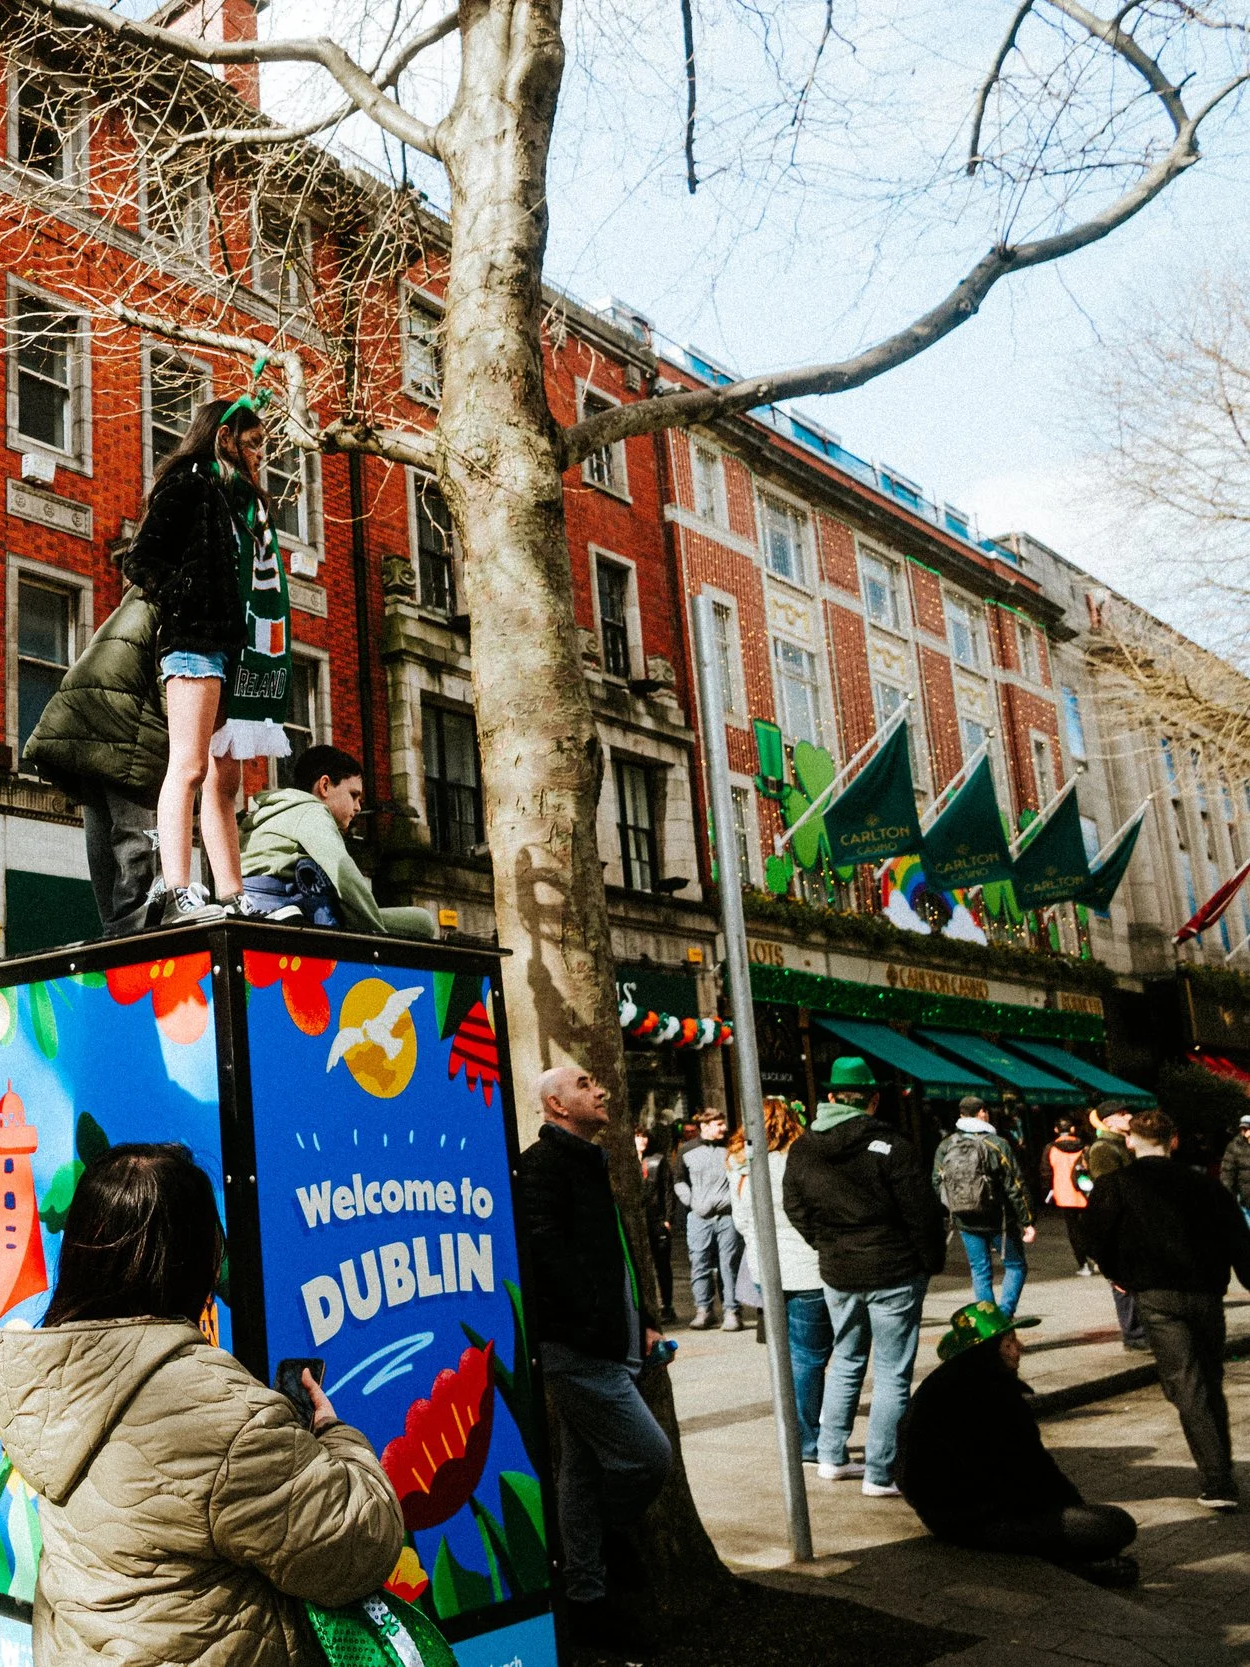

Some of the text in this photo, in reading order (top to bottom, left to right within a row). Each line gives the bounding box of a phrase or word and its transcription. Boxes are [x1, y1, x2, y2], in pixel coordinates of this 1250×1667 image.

[233, 665, 287, 700] IRELAND
[840, 827, 910, 847] CARLTON
[857, 841, 898, 856] CASINO
[935, 852, 999, 874] CARLTON
[746, 940, 784, 967] LOTS
[296, 1173, 494, 1228] Welcome to
[300, 1232, 495, 1347] DUBLIN
